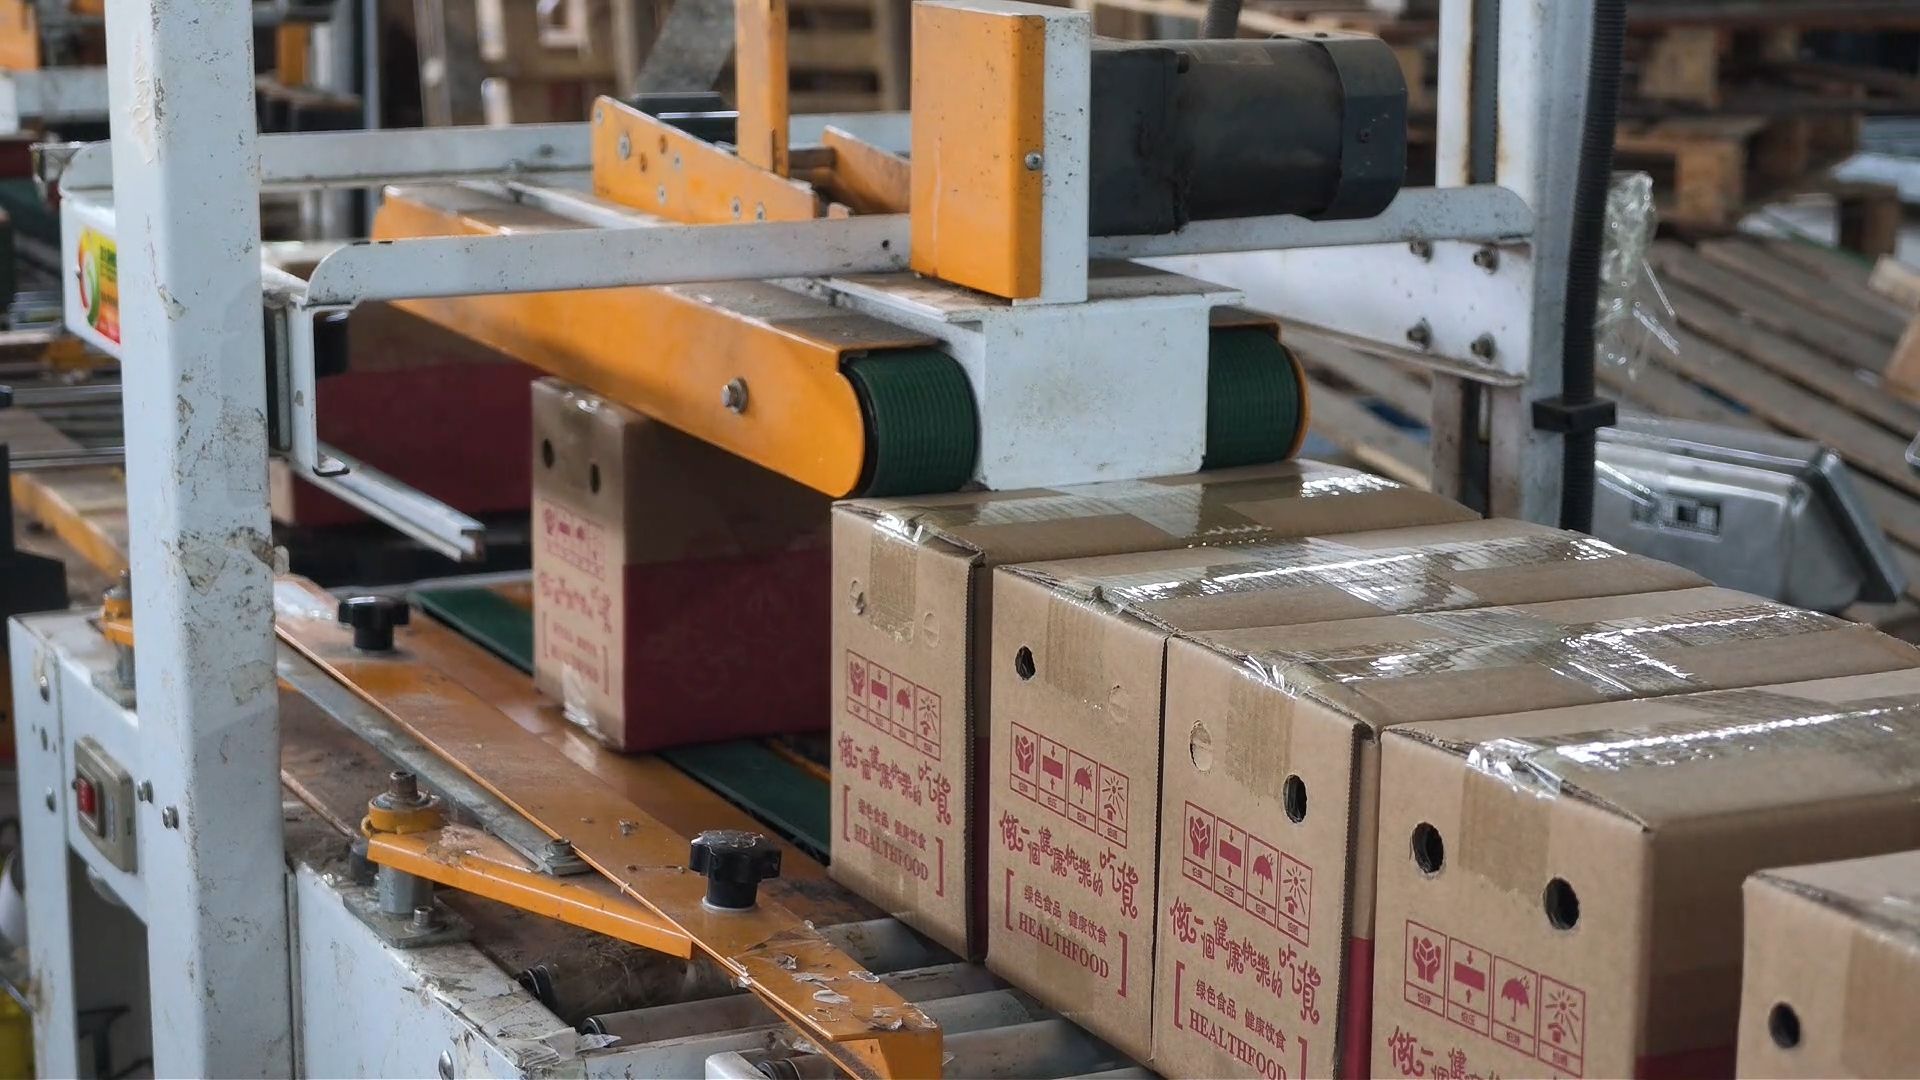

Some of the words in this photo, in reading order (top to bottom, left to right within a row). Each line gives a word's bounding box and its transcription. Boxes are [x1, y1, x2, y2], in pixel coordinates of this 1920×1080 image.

[854, 823, 928, 880] HEALTHFOOD
[1019, 912, 1109, 978] HEALTHFOOD
[1024, 885, 1061, 918] 绿色食品
[1069, 909, 1107, 946] 健康饮食
[1189, 1008, 1287, 1080] HEALTHFOOD
[1195, 979, 1236, 1020] 绿色食品
[1245, 1008, 1286, 1053] 健康饮食
